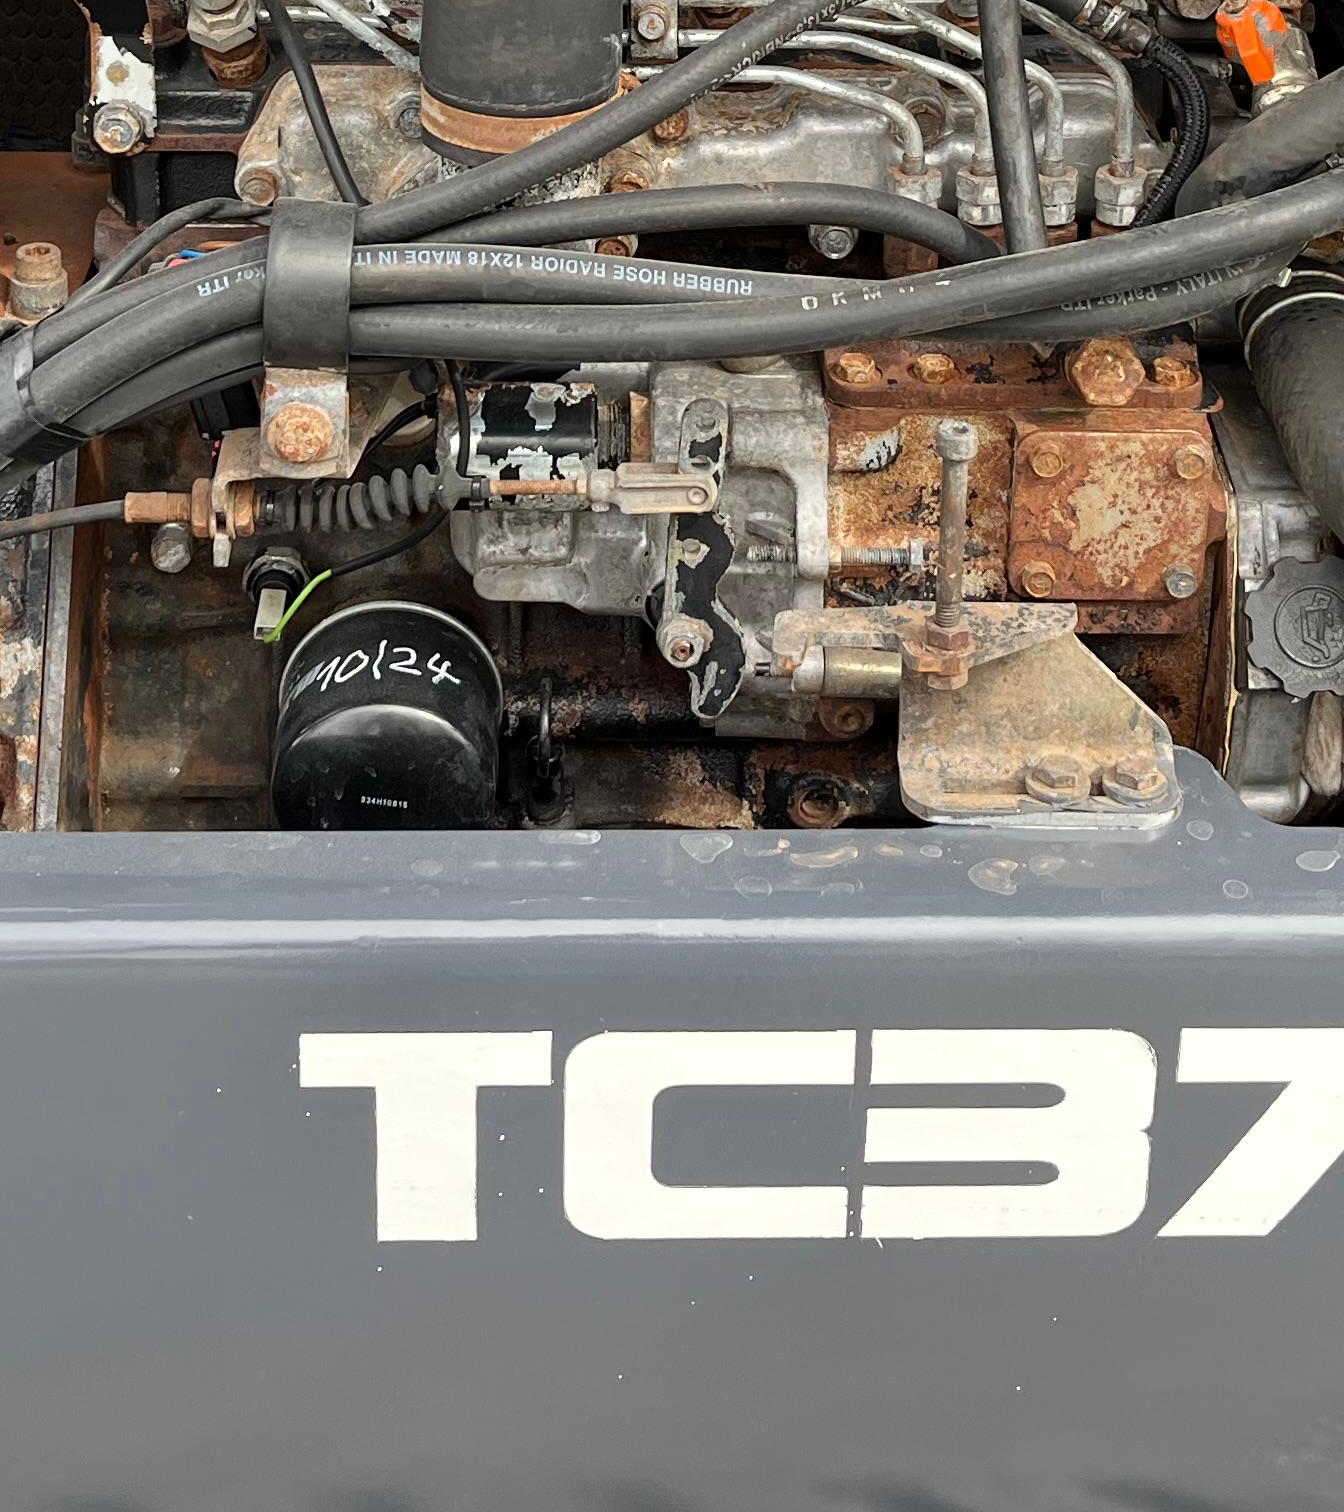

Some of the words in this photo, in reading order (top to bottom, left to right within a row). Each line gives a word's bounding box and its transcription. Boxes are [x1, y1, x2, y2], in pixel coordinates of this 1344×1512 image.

[378, 250, 398, 265] IN
[404, 250, 462, 265] MADE
[531, 256, 606, 278] RADIOR
[612, 264, 666, 286] HOSE
[672, 271, 753, 296] RUBBER
[197, 276, 230, 297] ITR
